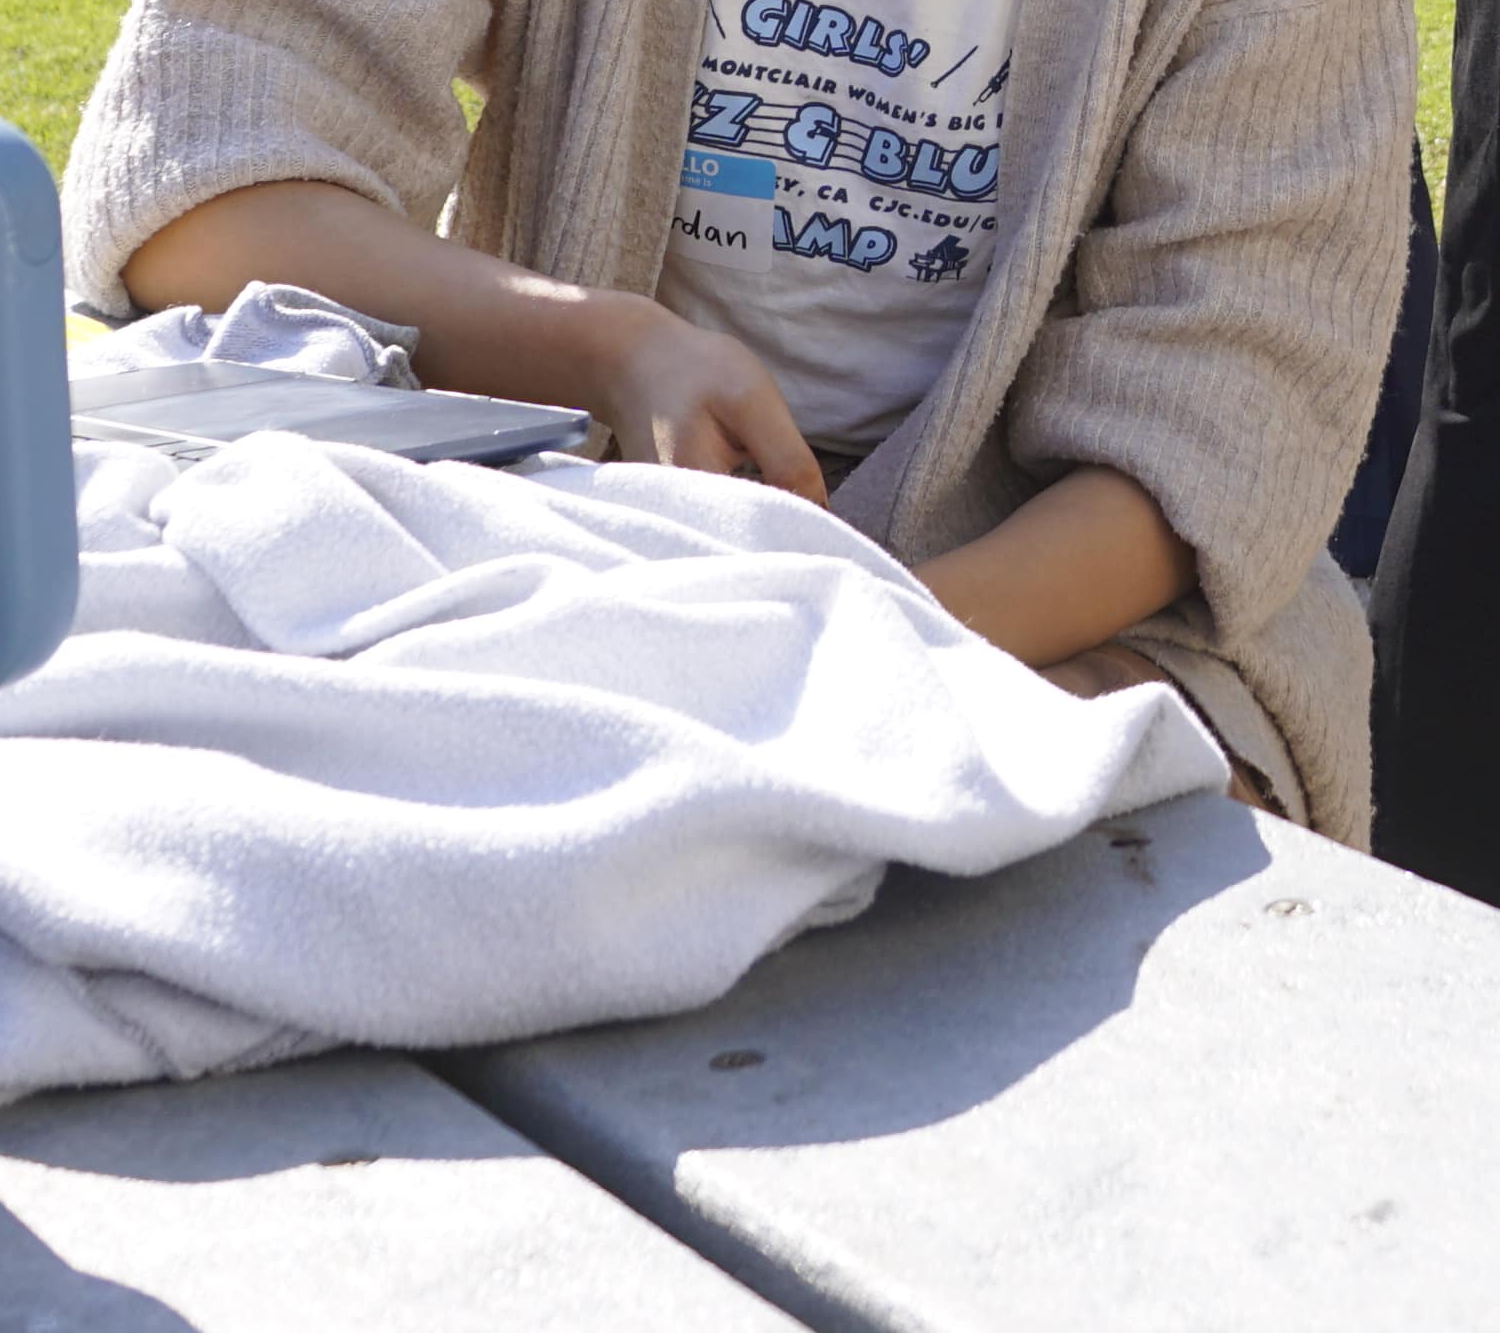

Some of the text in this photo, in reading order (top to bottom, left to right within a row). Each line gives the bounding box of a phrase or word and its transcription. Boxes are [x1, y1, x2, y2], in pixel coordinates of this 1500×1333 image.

[702, 55, 838, 95] MONTCLAIR
[848, 84, 938, 128] WOMEN'S
[948, 113, 986, 131] BIG
[860, 126, 999, 199] BLU
[817, 185, 849, 203] CA
[869, 196, 997, 233] CJC.EDU/G
